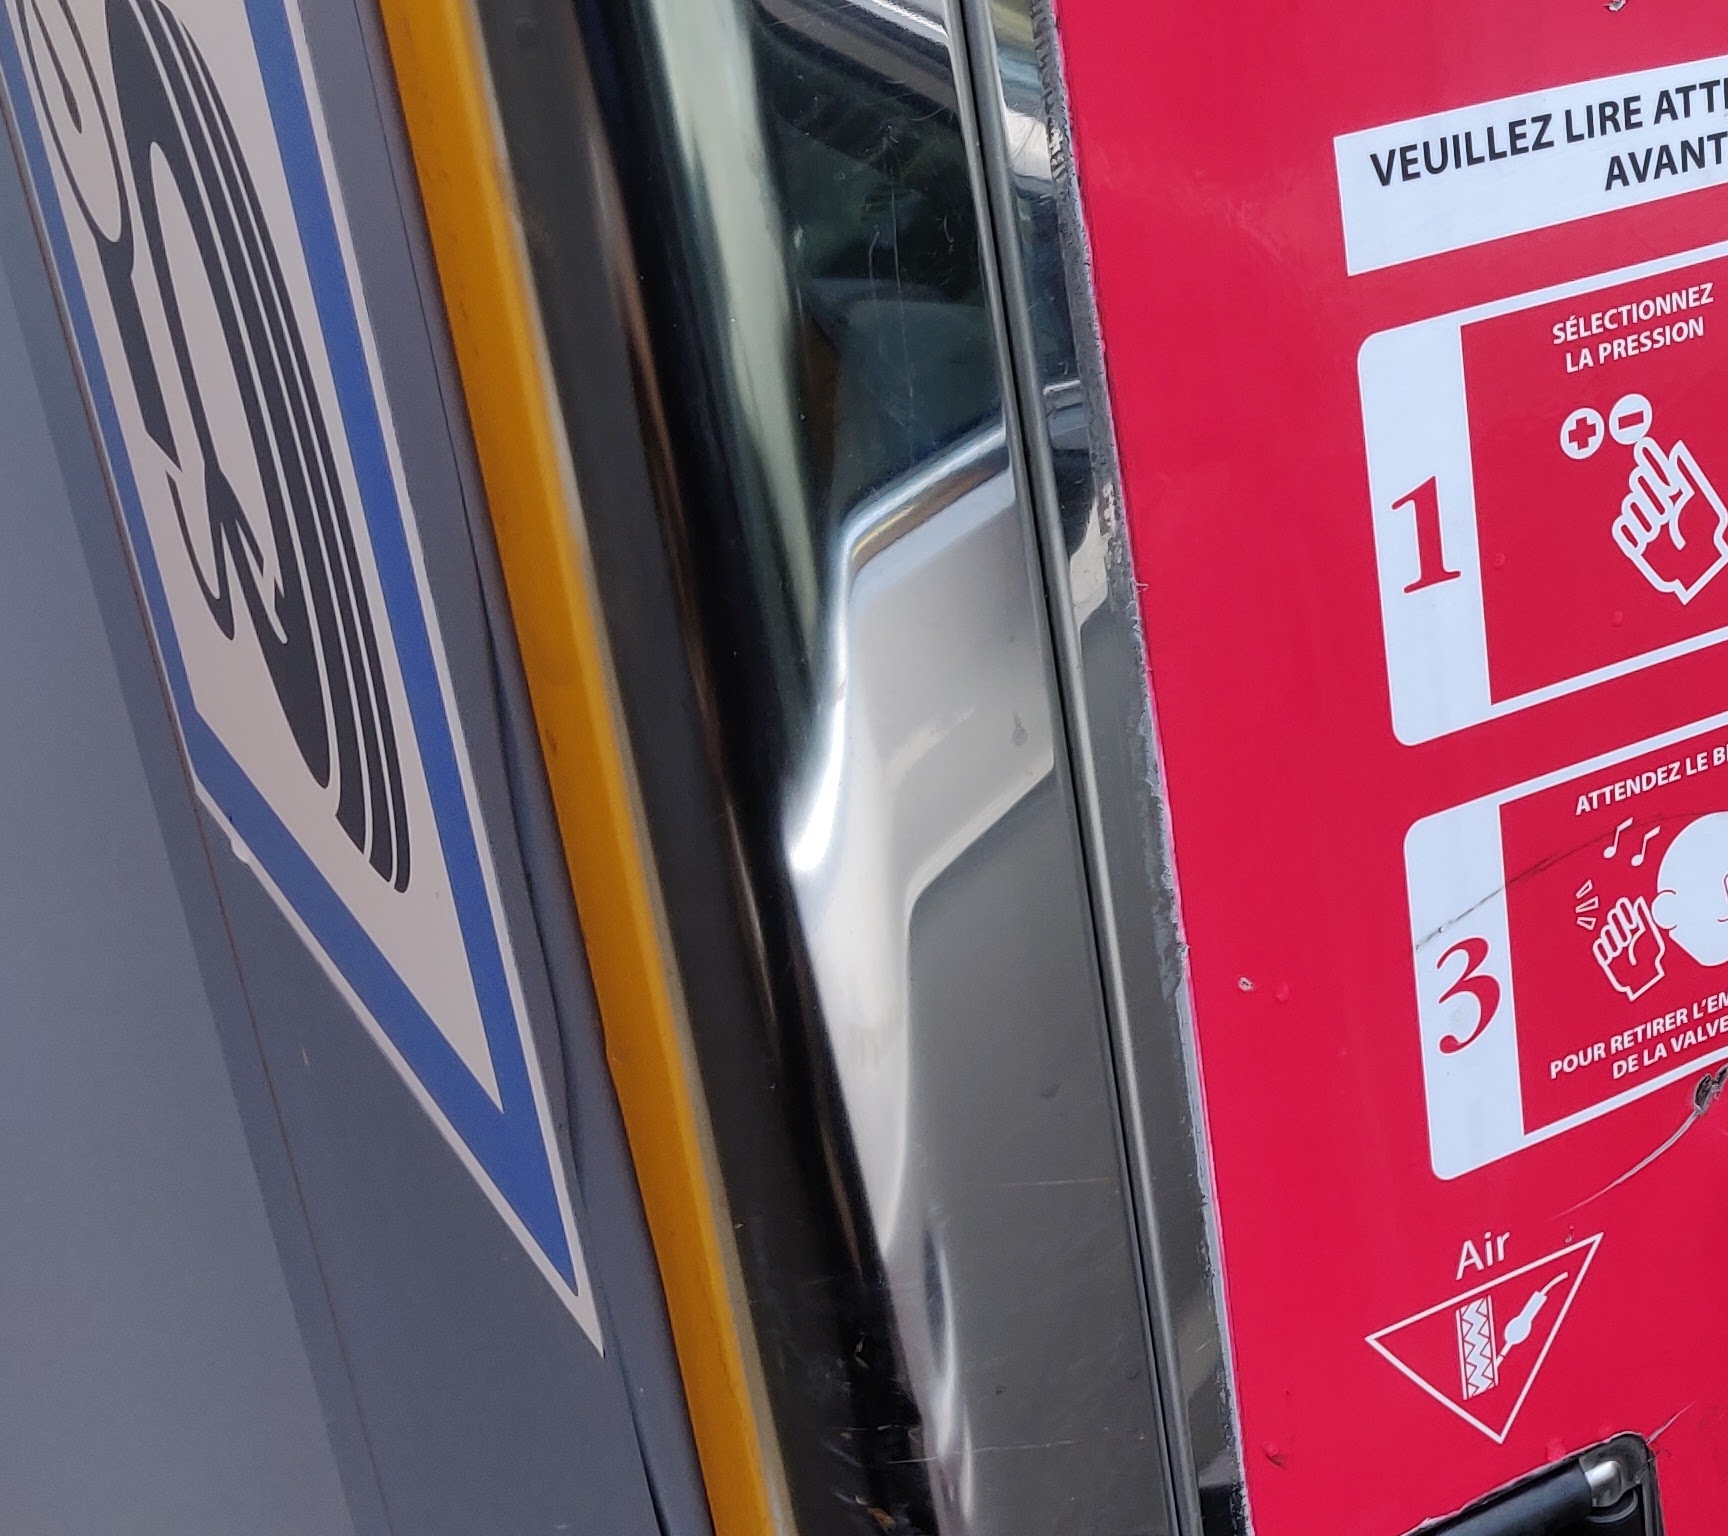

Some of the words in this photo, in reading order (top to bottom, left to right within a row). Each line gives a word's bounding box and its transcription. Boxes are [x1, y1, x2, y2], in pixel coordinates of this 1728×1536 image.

[1369, 112, 1554, 187] VEUILLEZ
[1564, 94, 1643, 143] LIRE
[1604, 130, 1728, 191] AVANT
[1552, 282, 1713, 344] SÉLECTIONNEZ
[1565, 347, 1593, 373] LA
[1598, 315, 1704, 364] PRESSION
[1392, 476, 1461, 593] 1
[1575, 760, 1681, 815] ATTENDEZ
[1685, 751, 1708, 775] LE
[1437, 938, 1500, 1053] 3
[1550, 1041, 1606, 1079] POUR
[1610, 1007, 1688, 1054] RETIRER
[1612, 1053, 1639, 1079] DE
[1642, 1042, 1667, 1066] LA
[1455, 1231, 1511, 1281] Air
